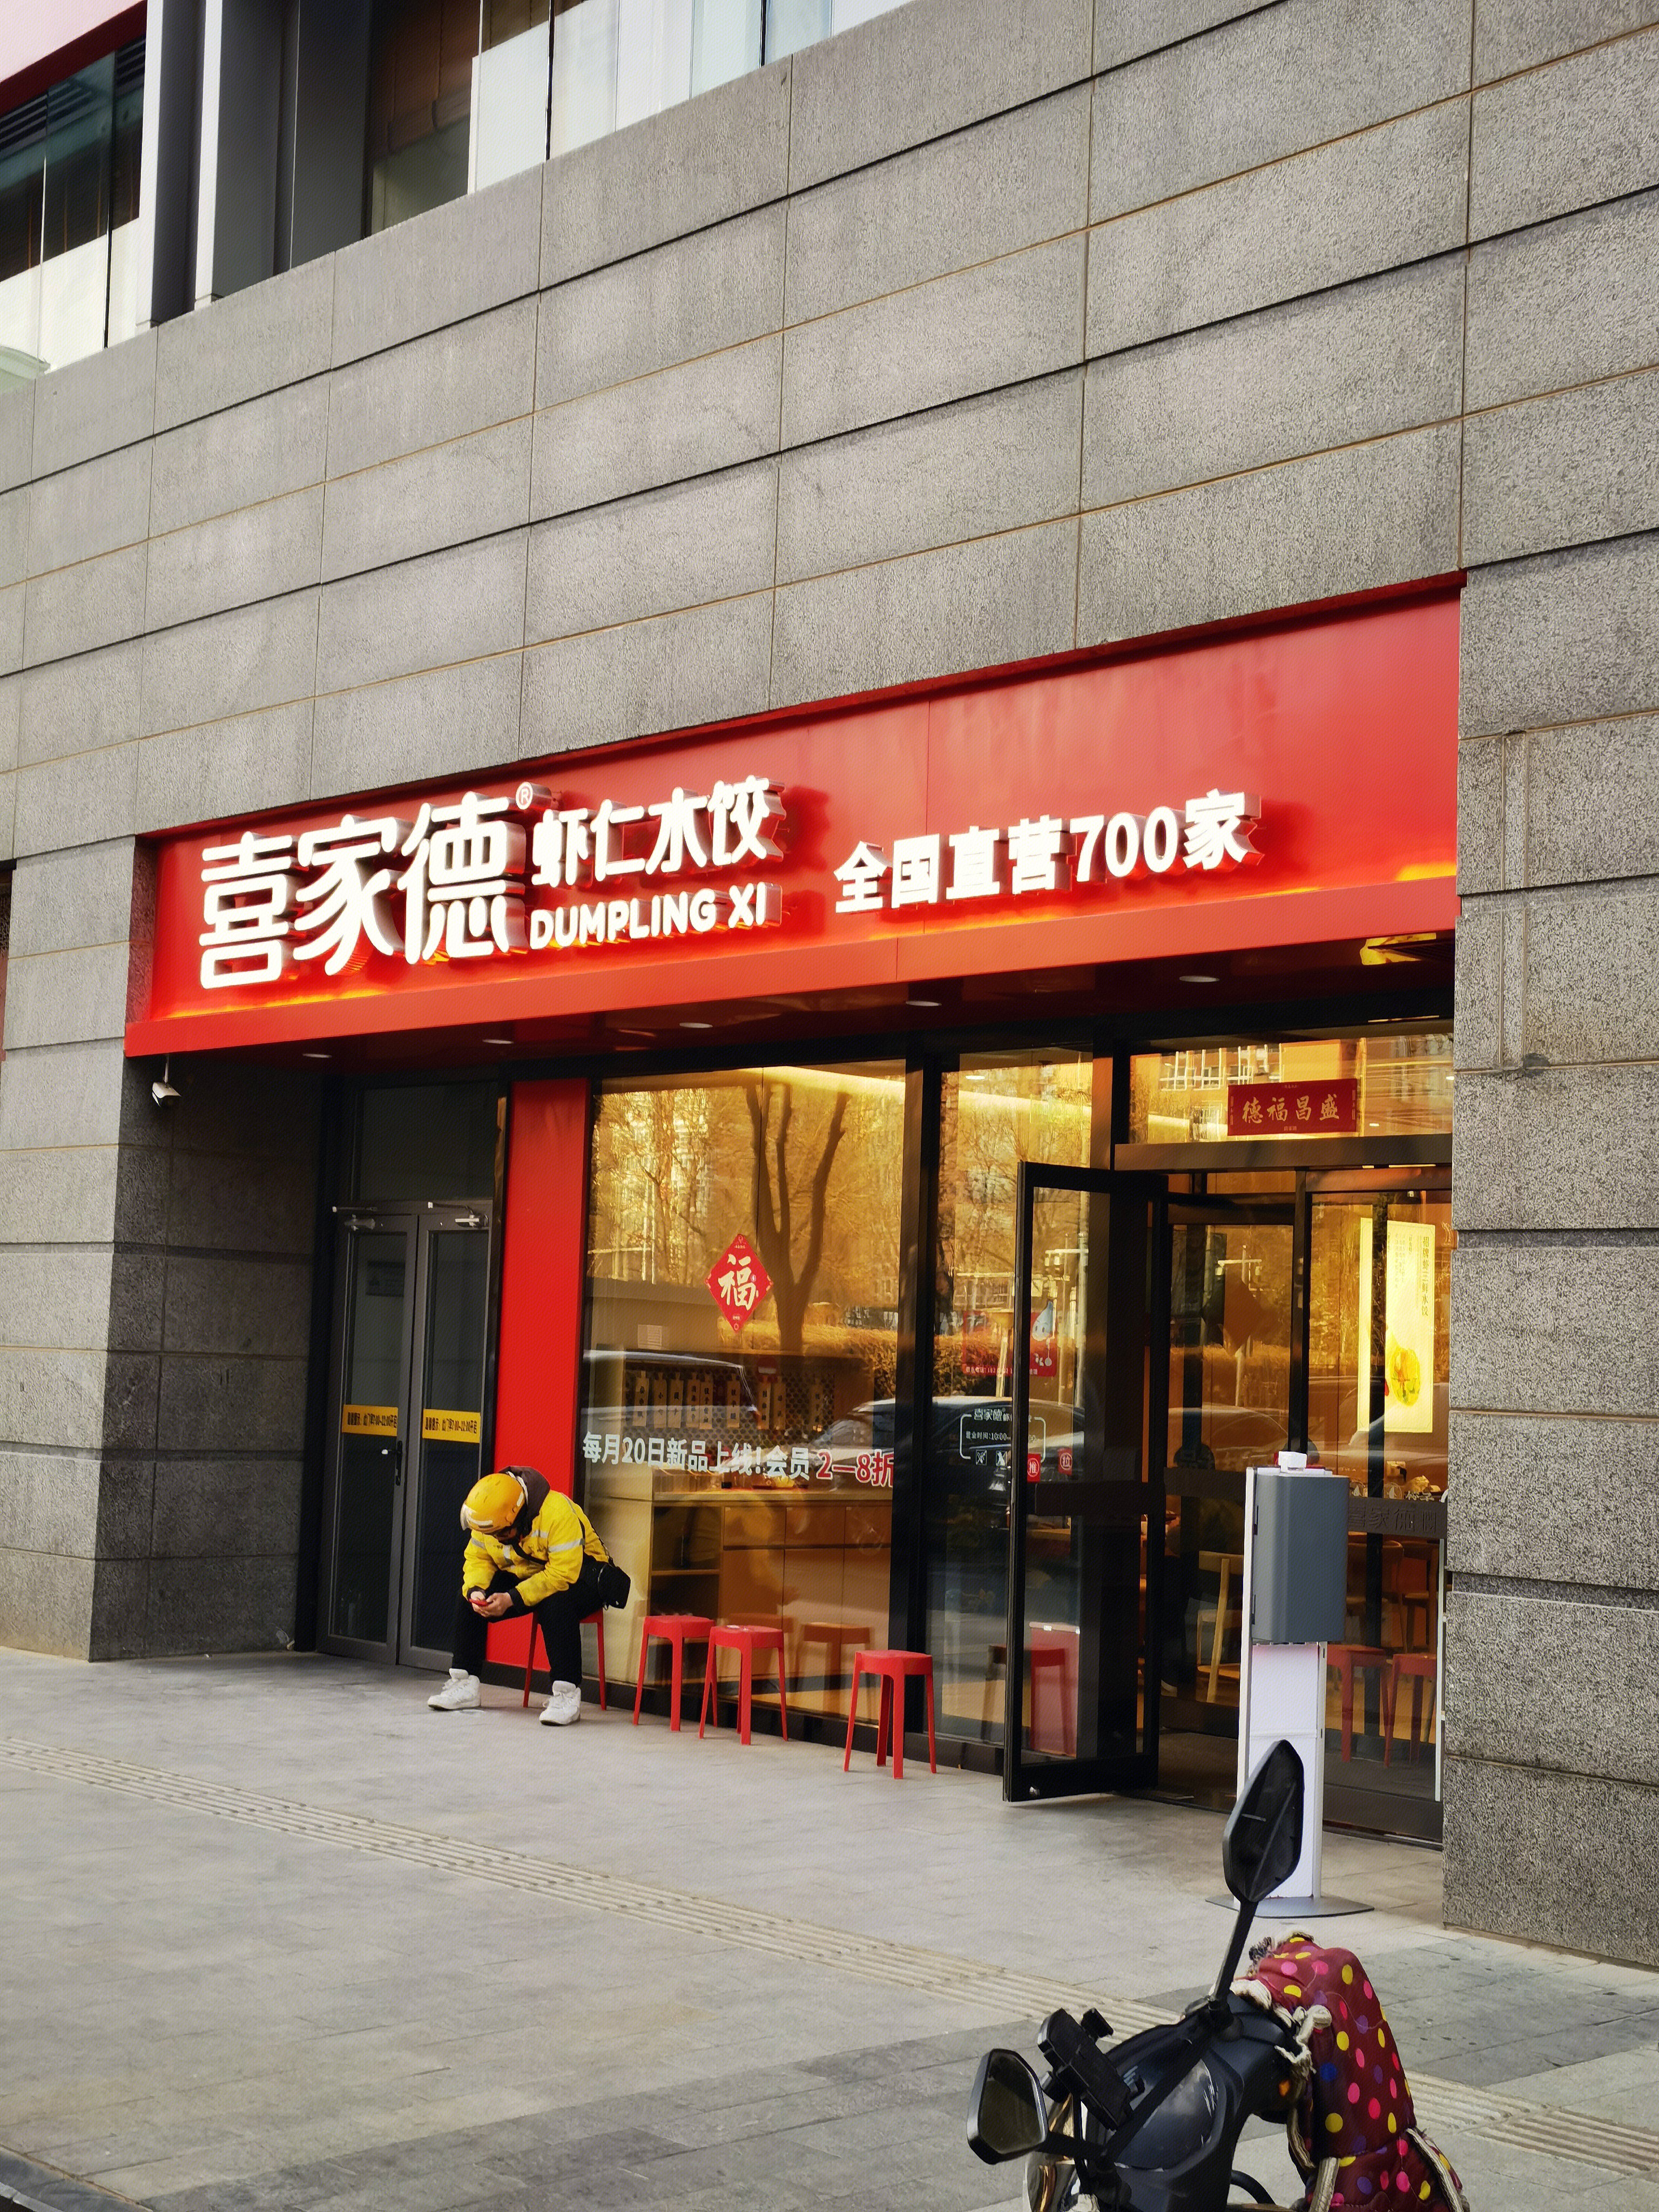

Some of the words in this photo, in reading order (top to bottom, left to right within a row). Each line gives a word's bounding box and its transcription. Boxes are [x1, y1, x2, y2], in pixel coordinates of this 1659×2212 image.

[531, 774, 770, 887] 虾仁水饺
[833, 788, 1249, 914] 全国直营700家
[200, 791, 511, 989] 喜家德
[529, 896, 716, 950] DUMPLING
[727, 882, 766, 929] XI
[718, 1254, 756, 1311] 福
